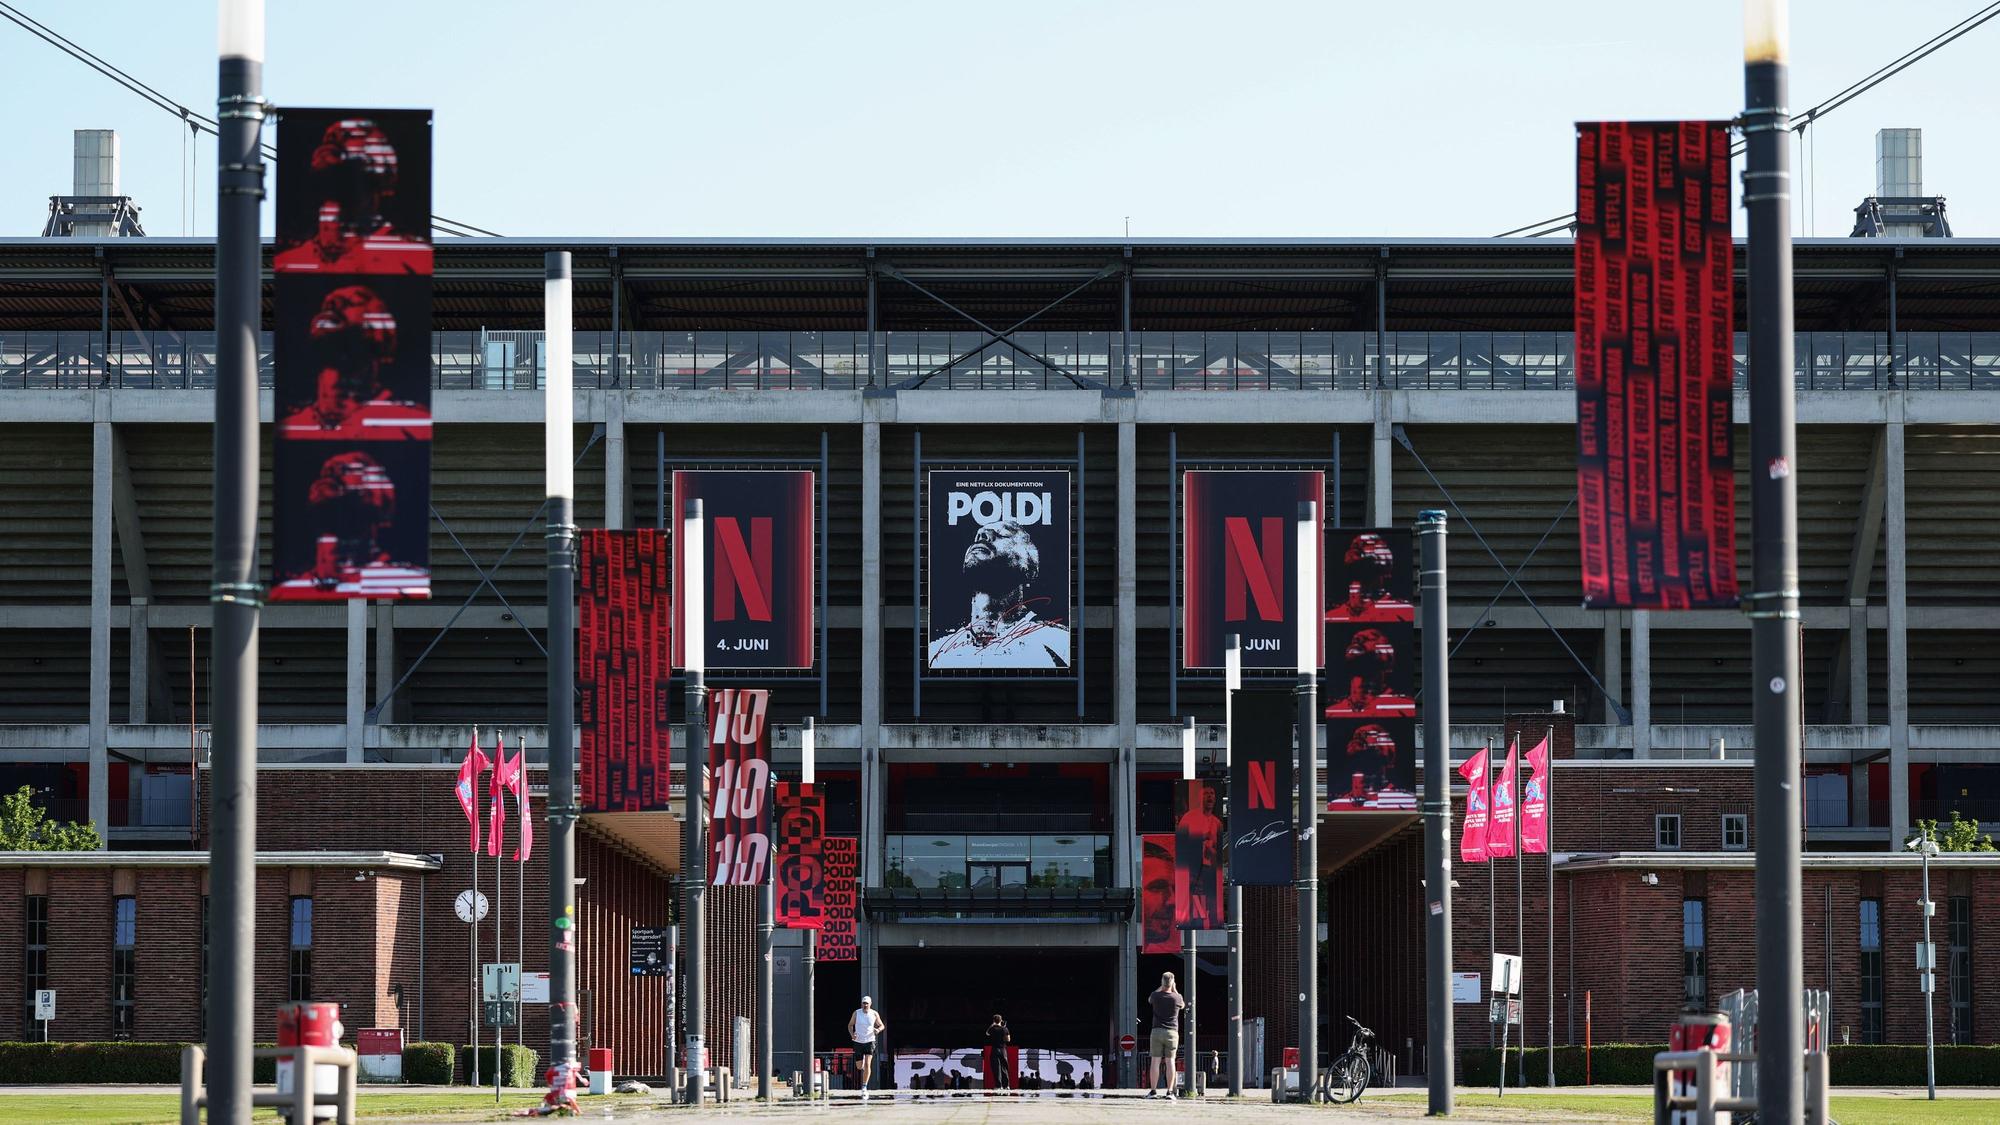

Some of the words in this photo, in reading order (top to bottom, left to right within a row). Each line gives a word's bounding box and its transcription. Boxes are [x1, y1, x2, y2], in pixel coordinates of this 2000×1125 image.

[1658, 132, 1674, 188] NETFLIX
[1606, 183, 1621, 238] NETFLIX
[1581, 401, 1597, 455] NETFLIX
[1711, 401, 1728, 456] NETFLIX
[948, 491, 1052, 525] POLDI
[714, 517, 772, 622] N
[1225, 517, 1284, 622] N
[716, 638, 731, 650] 4.
[734, 638, 769, 650] JUNI
[1245, 639, 1280, 650] JUNI
[713, 690, 768, 744] 10
[713, 758, 768, 819] 10
[1248, 761, 1276, 810] N
[712, 833, 768, 886] 10
[824, 839, 850, 851] OLDI
[824, 894, 850, 906] OLDI
[824, 921, 852, 932] OLDI
[818, 948, 856, 960] POLDI
[43, 992, 48, 1002] P
